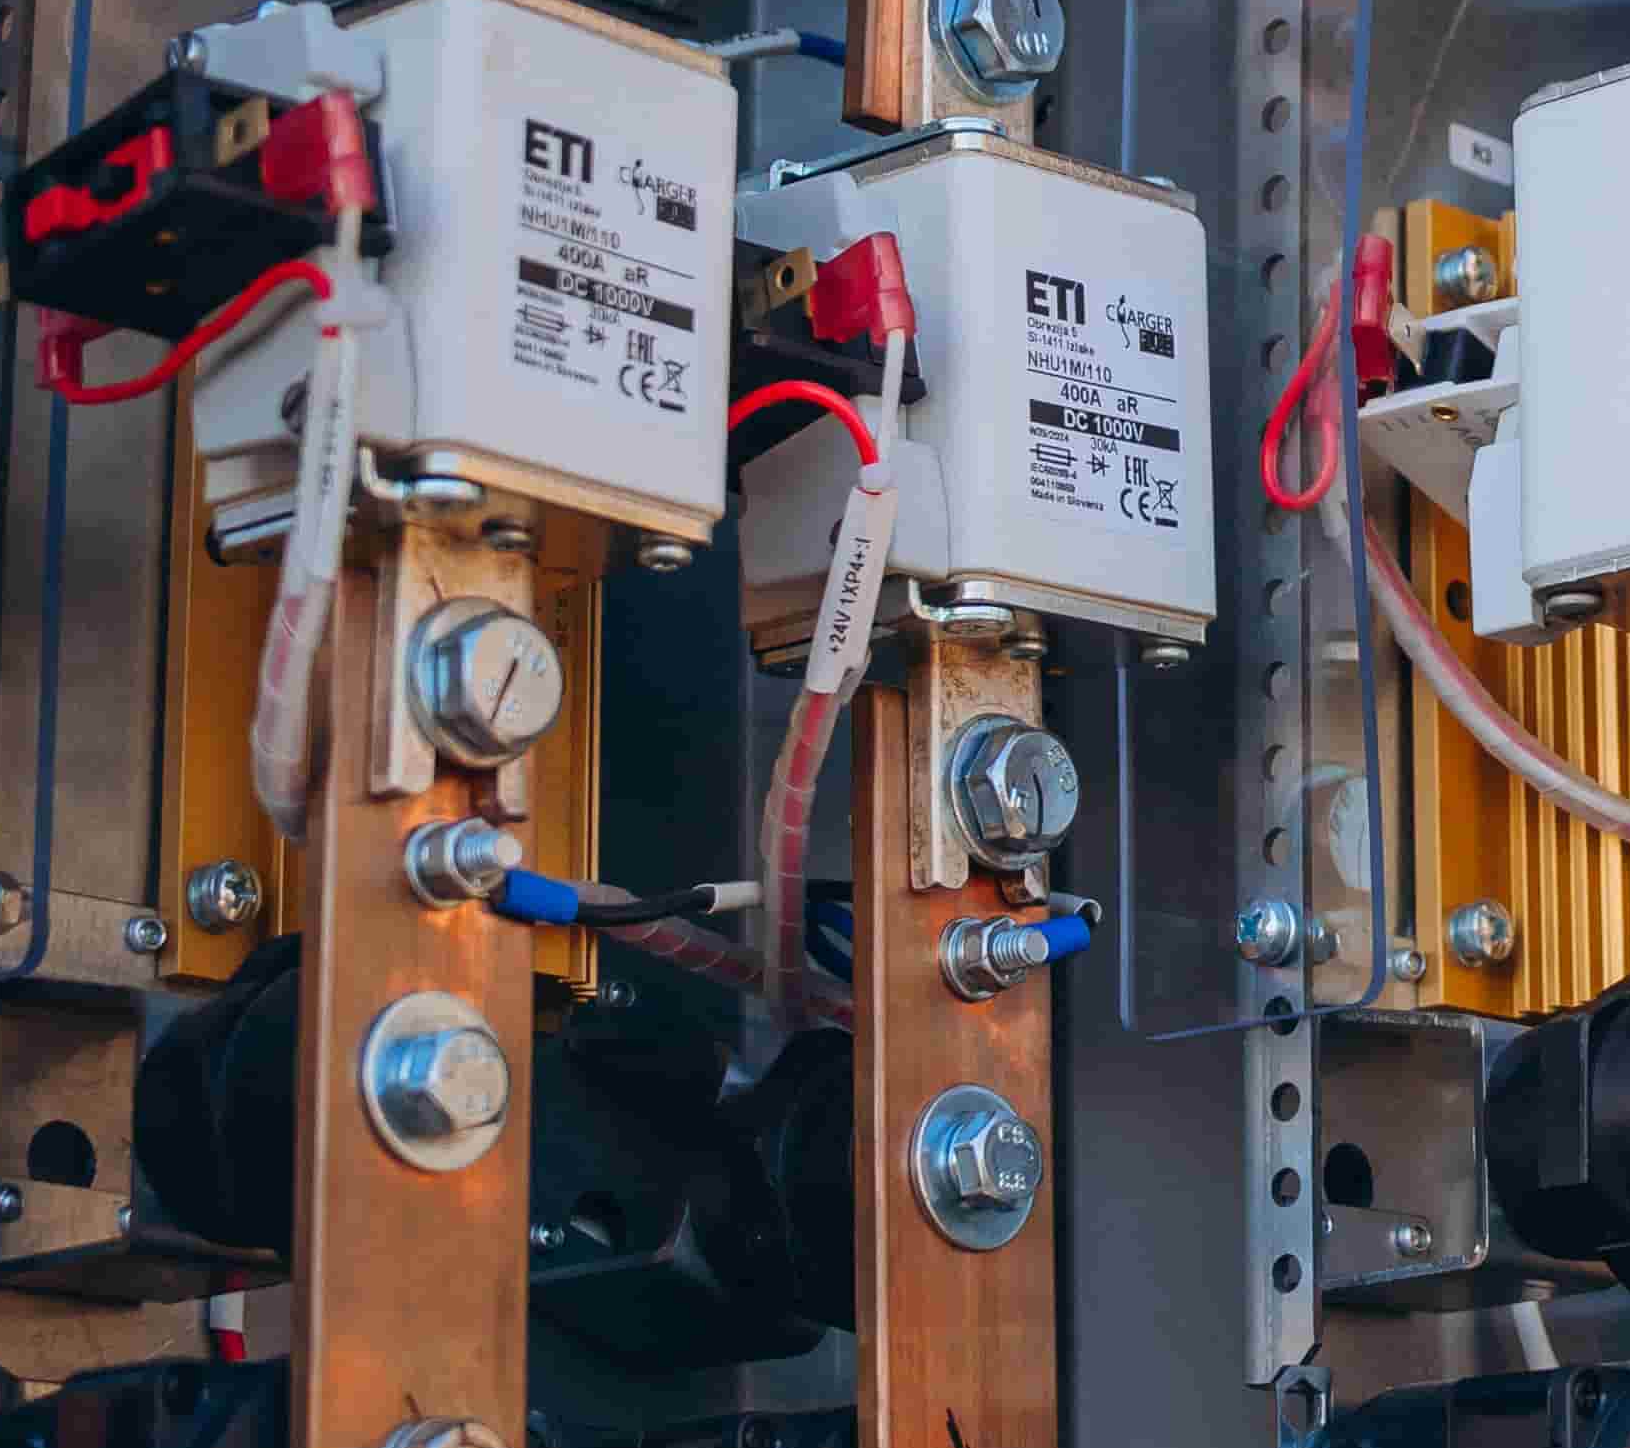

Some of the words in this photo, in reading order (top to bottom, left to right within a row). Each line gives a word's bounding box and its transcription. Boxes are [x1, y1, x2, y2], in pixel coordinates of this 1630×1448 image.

[525, 117, 593, 184] ETI
[558, 243, 606, 272] 400A
[623, 265, 651, 288] aR
[592, 282, 657, 317] 1000V
[1026, 269, 1085, 326] ETI
[1105, 294, 1174, 335] CHARGER
[1027, 350, 1112, 384] NHU1M/110
[1060, 382, 1103, 409] 400A
[1117, 396, 1140, 416] aR
[1063, 409, 1089, 431] DC
[1093, 415, 1145, 444] 1000V
[1120, 487, 1152, 523] CE
[829, 607, 853, 656] +24V
